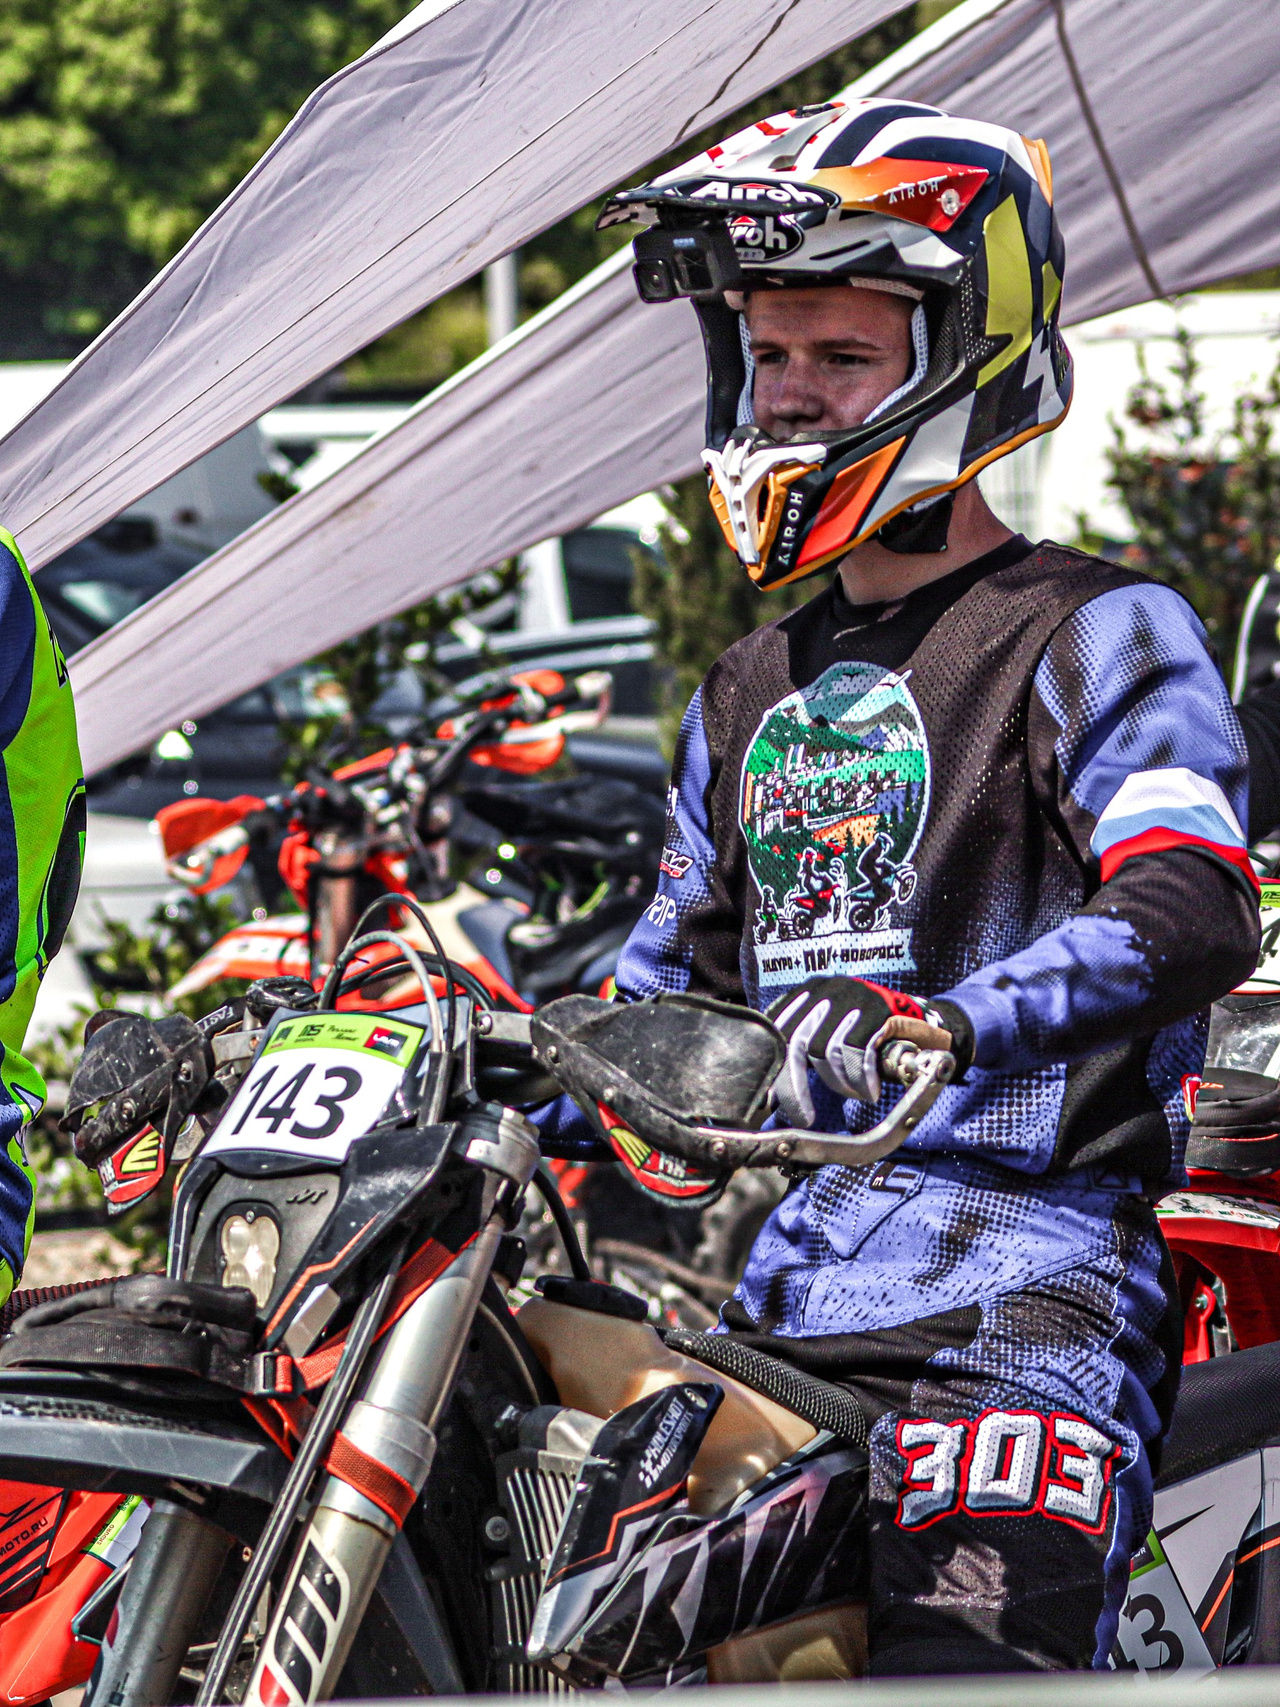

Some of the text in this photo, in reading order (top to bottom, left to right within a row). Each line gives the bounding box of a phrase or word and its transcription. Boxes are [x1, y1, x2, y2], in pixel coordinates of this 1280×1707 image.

[690, 181, 824, 204] Airoh
[888, 180, 939, 205] AIROH
[778, 491, 803, 566] AIROH
[230, 1063, 363, 1139] 143
[647, 1396, 685, 1460] HOLESHOT
[896, 1408, 1120, 1535] 303
